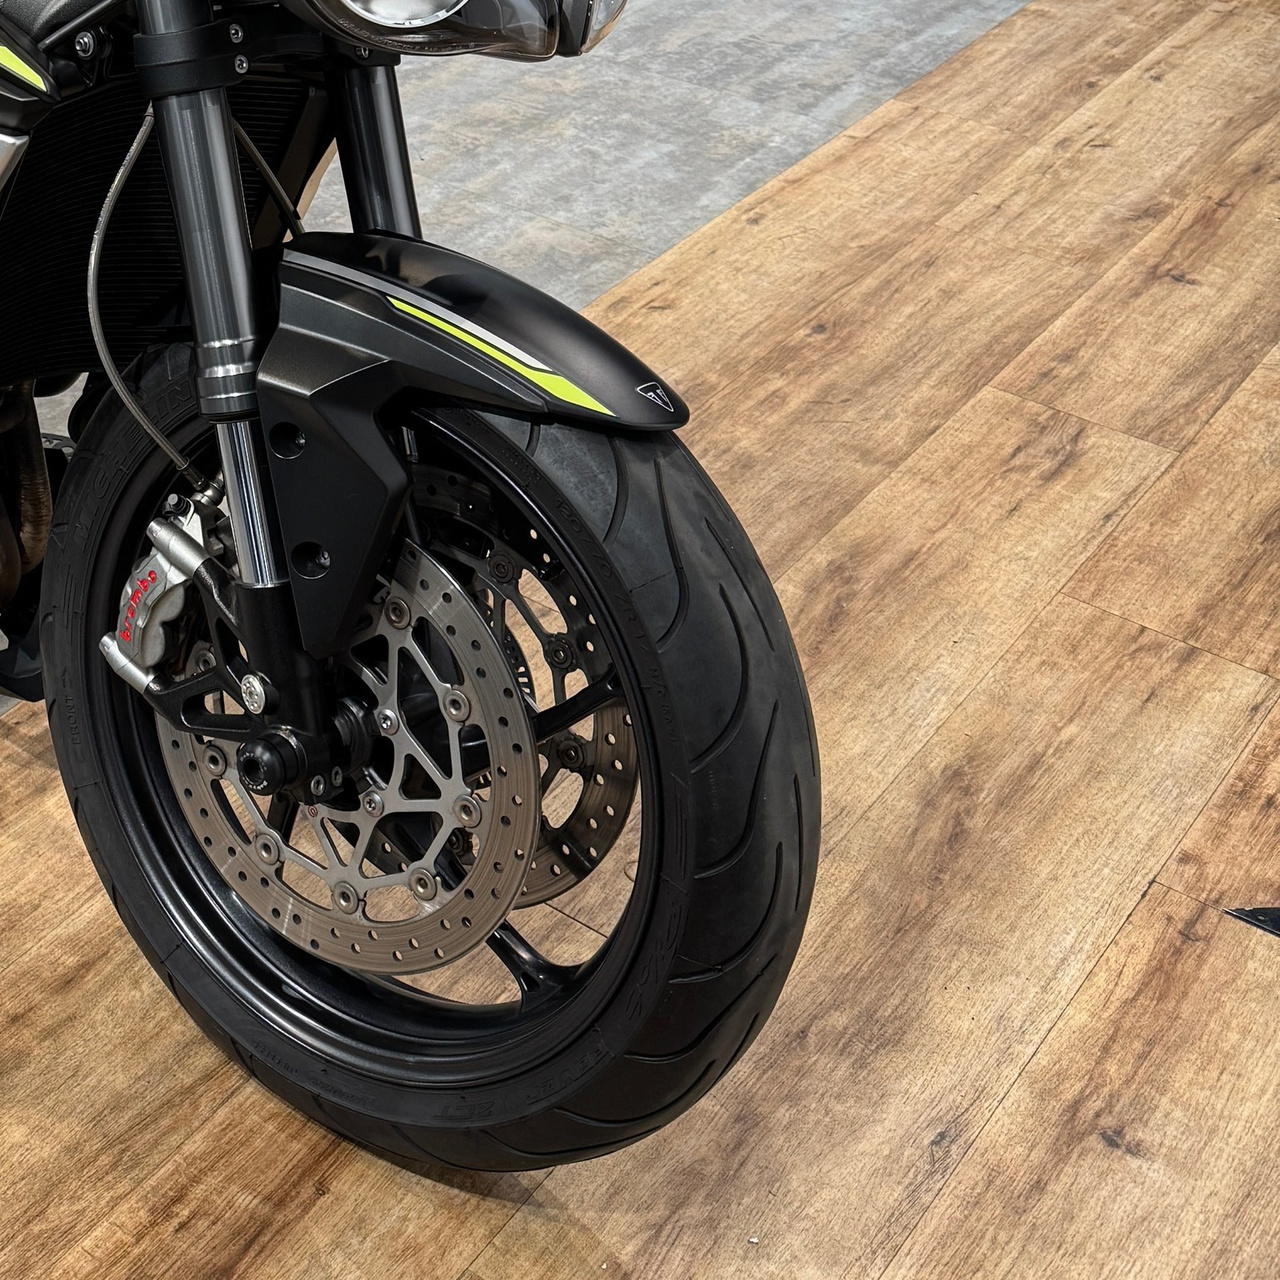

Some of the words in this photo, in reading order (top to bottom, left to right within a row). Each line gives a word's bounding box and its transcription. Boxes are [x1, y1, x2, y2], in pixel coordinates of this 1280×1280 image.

[69, 373, 198, 555] MICHEIN
[119, 570, 157, 643] brembo
[65, 695, 82, 746] FRONT
